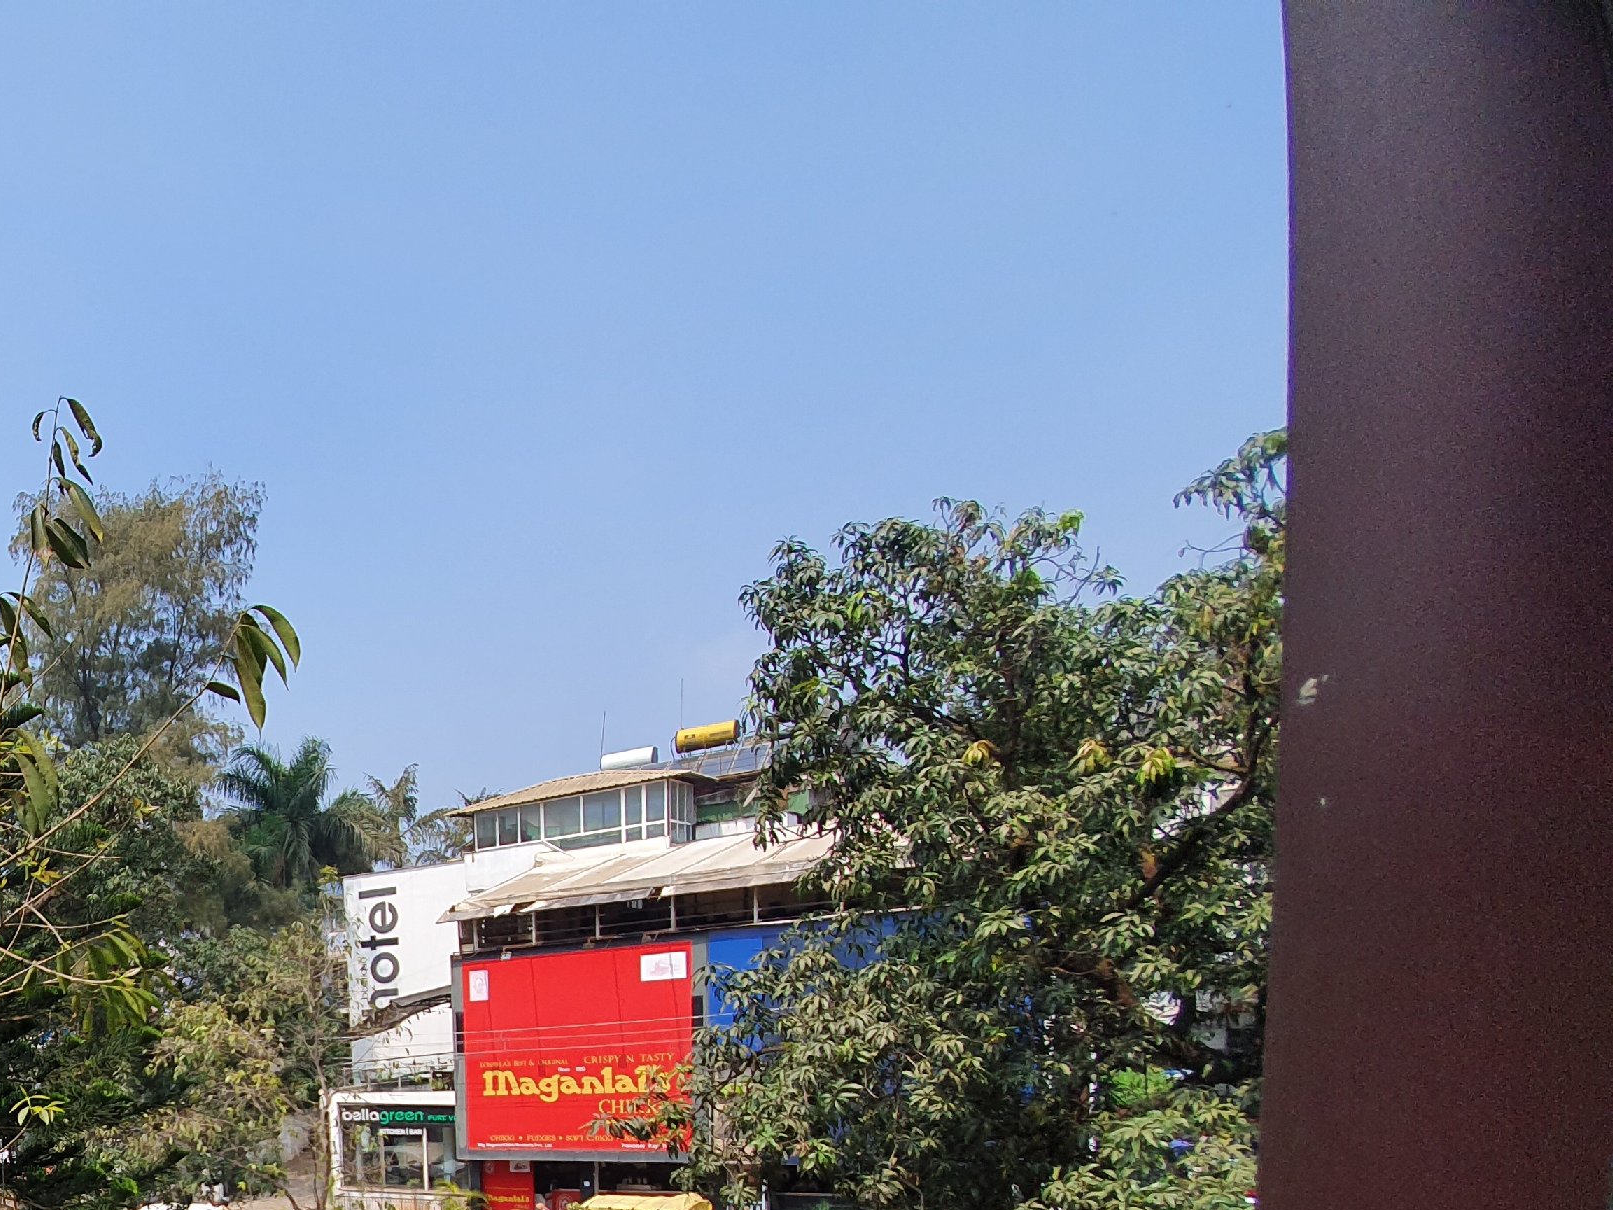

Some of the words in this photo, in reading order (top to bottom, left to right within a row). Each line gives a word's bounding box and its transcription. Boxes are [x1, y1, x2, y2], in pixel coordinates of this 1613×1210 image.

[358, 886, 400, 1016] hotel
[583, 1054, 620, 1065] CRISPY
[639, 1052, 674, 1062] TASTY
